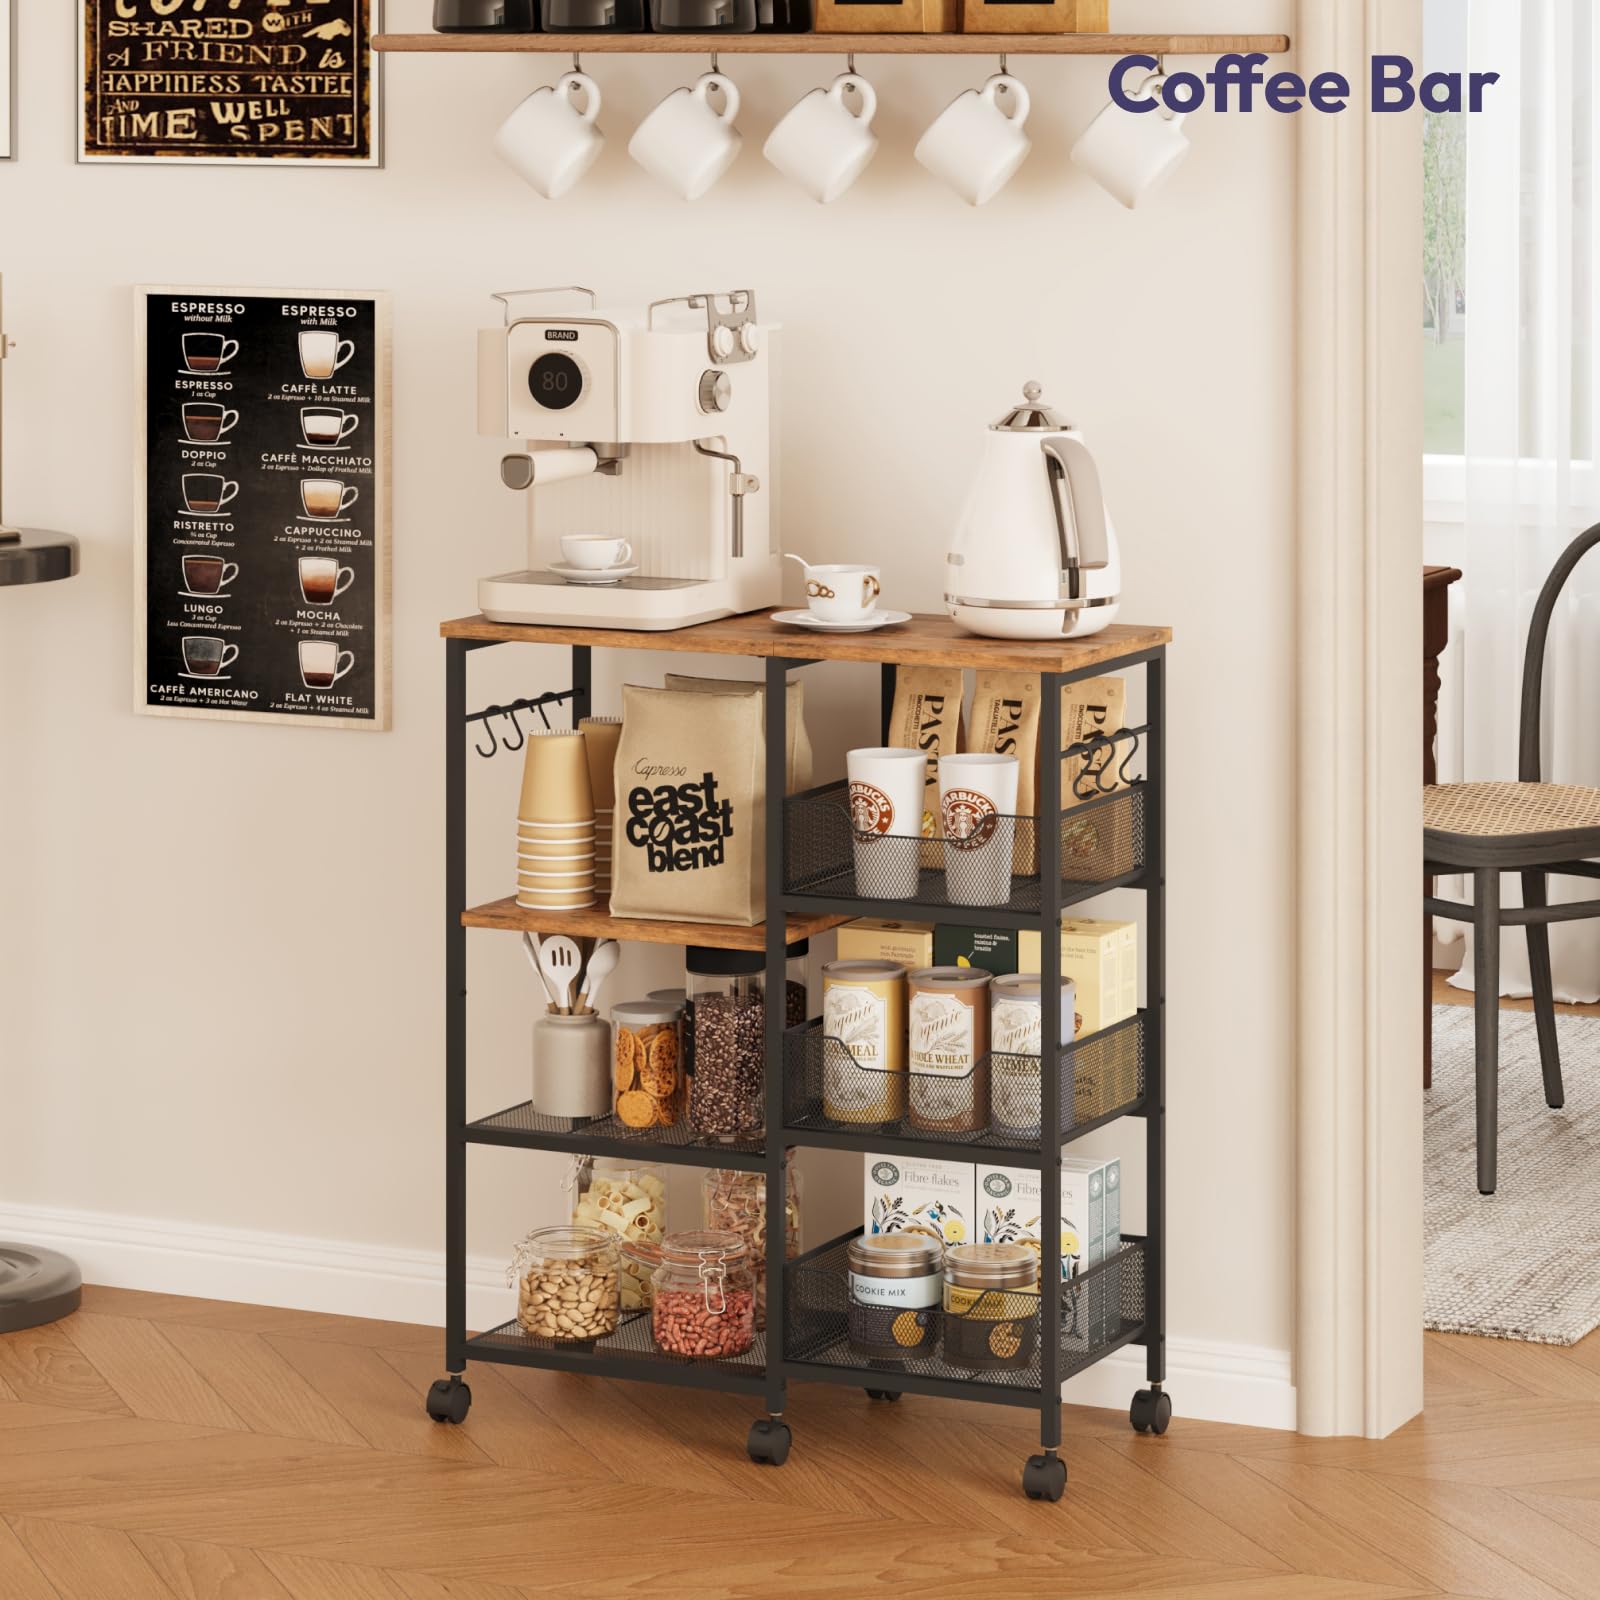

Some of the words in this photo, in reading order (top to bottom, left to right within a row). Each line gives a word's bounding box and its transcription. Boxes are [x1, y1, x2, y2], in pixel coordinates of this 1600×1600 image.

[108, 18, 253, 39] SHARED
[263, 12, 312, 30] WITH
[107, 47, 130, 67] A
[141, 40, 308, 65] FRIEND
[318, 48, 346, 69] is
[102, 74, 241, 94] HAPPINESS
[106, 98, 139, 115] AND
[209, 99, 290, 124] WELL
[102, 108, 198, 142] TIME
[230, 114, 353, 142] SPENT
[171, 302, 245, 314] ESPRESSO
[282, 305, 357, 317] ESPRESSO
[184, 314, 213, 322] without
[215, 315, 232, 323] Milk
[320, 318, 338, 326] Milk
[547, 331, 576, 340] BRAND
[175, 380, 233, 390] ESPRESSO
[542, 371, 568, 391] 80
[281, 383, 317, 393] CAFFÈ
[322, 385, 357, 395] LATTE
[181, 450, 226, 460] DOPPIO
[261, 452, 297, 463] CAFFÈ
[302, 455, 372, 466] MACCHIATO
[173, 520, 234, 532] RISTRETTO
[285, 526, 361, 538] CAPPUCCINO
[184, 603, 224, 614] LUNGO
[296, 610, 340, 621] MOCHA
[150, 684, 185, 694] CAFFÈ
[190, 687, 259, 699] AMERICANO
[285, 693, 311, 702] FLAT
[316, 695, 353, 705] WHITE
[995, 699, 1022, 755] PAS
[633, 757, 687, 780] Capresso
[628, 771, 719, 818] east
[851, 784, 891, 812] RBUCKS
[626, 798, 733, 848] coast
[647, 834, 724, 872] blend
[935, 1054, 970, 1065] WHEAT
[904, 1170, 928, 1184] Fibre
[931, 1173, 960, 1187] flakes
[855, 1284, 885, 1296] COOKIE
[888, 1288, 906, 1297] MIX
